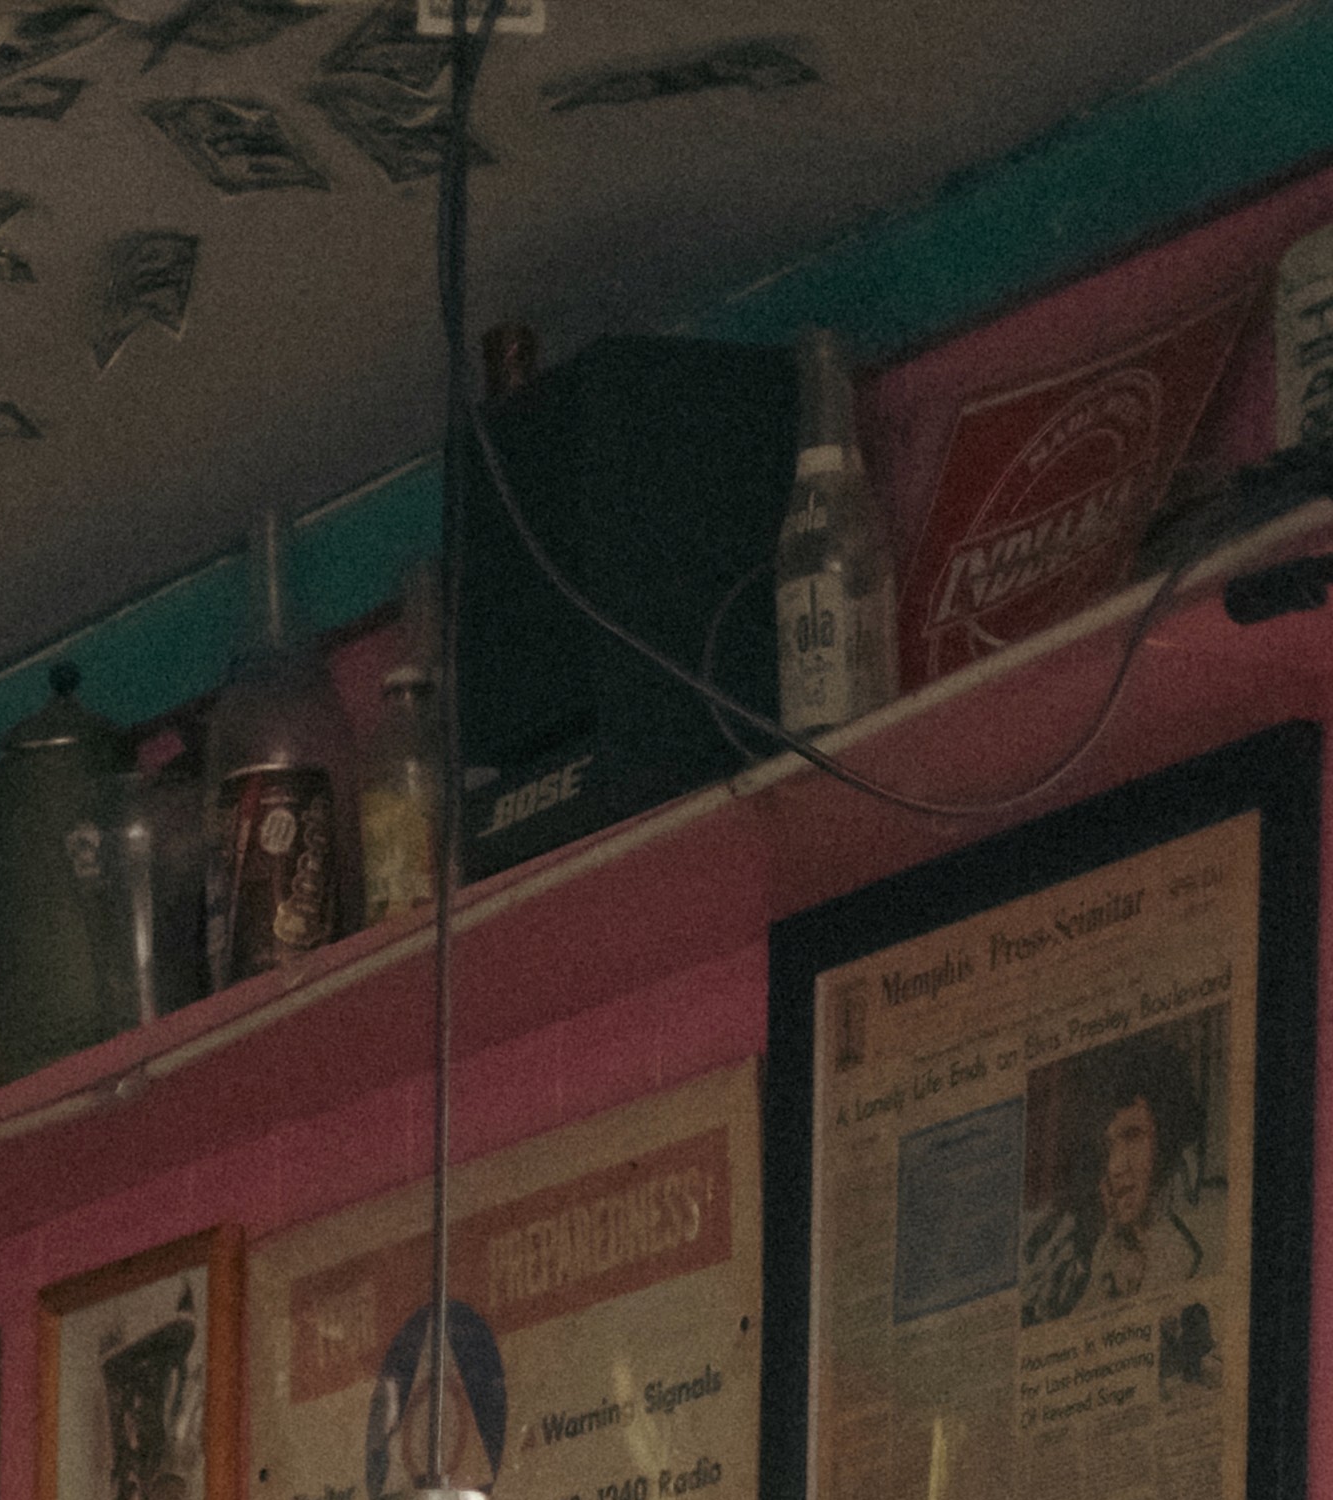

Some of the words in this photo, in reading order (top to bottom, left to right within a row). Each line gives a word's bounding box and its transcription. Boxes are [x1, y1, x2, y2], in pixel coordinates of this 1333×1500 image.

[481, 757, 593, 838] BOSE
[997, 1049, 1017, 1070] on
[541, 1391, 636, 1445] Warning
[644, 1366, 723, 1415] Signals
[658, 1457, 723, 1497] Radio
